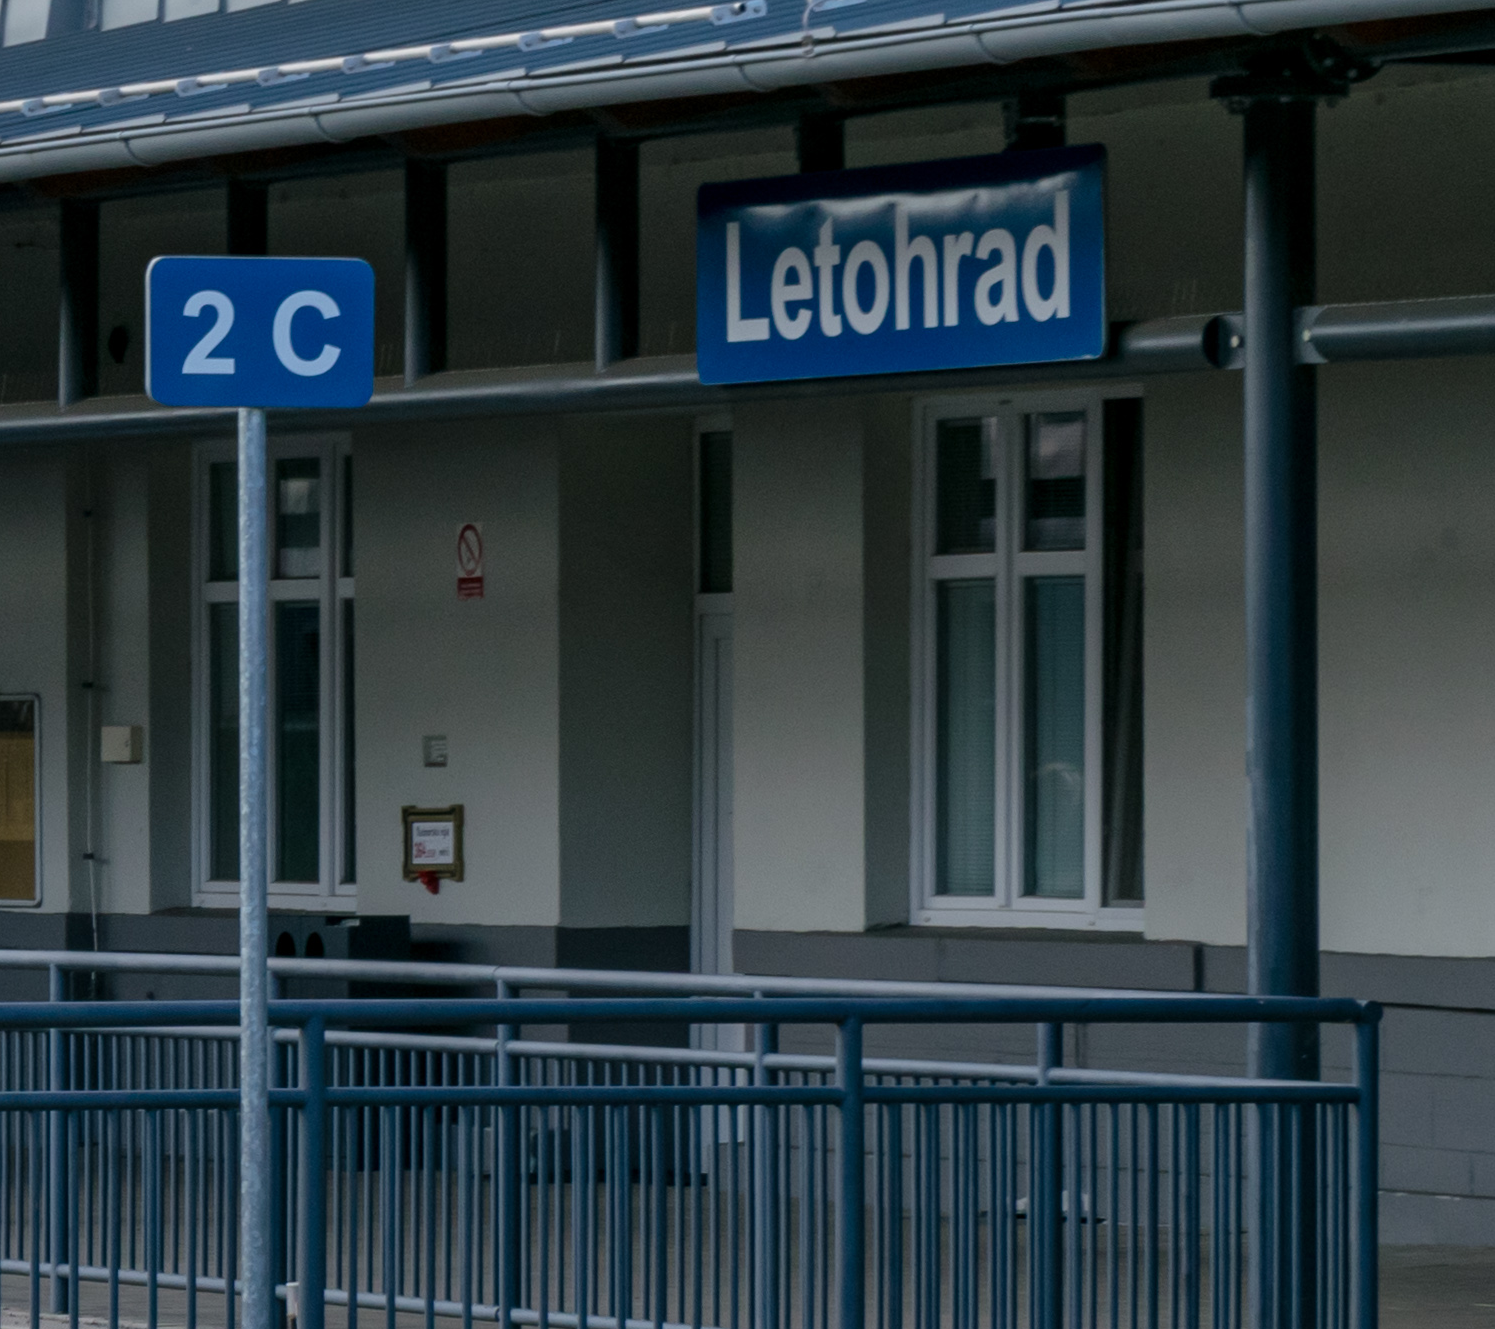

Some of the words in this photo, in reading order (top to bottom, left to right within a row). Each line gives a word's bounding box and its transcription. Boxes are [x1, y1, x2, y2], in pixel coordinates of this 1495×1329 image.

[725, 189, 1071, 343] Letohrad
[181, 289, 236, 375] 2
[272, 289, 342, 377] C
